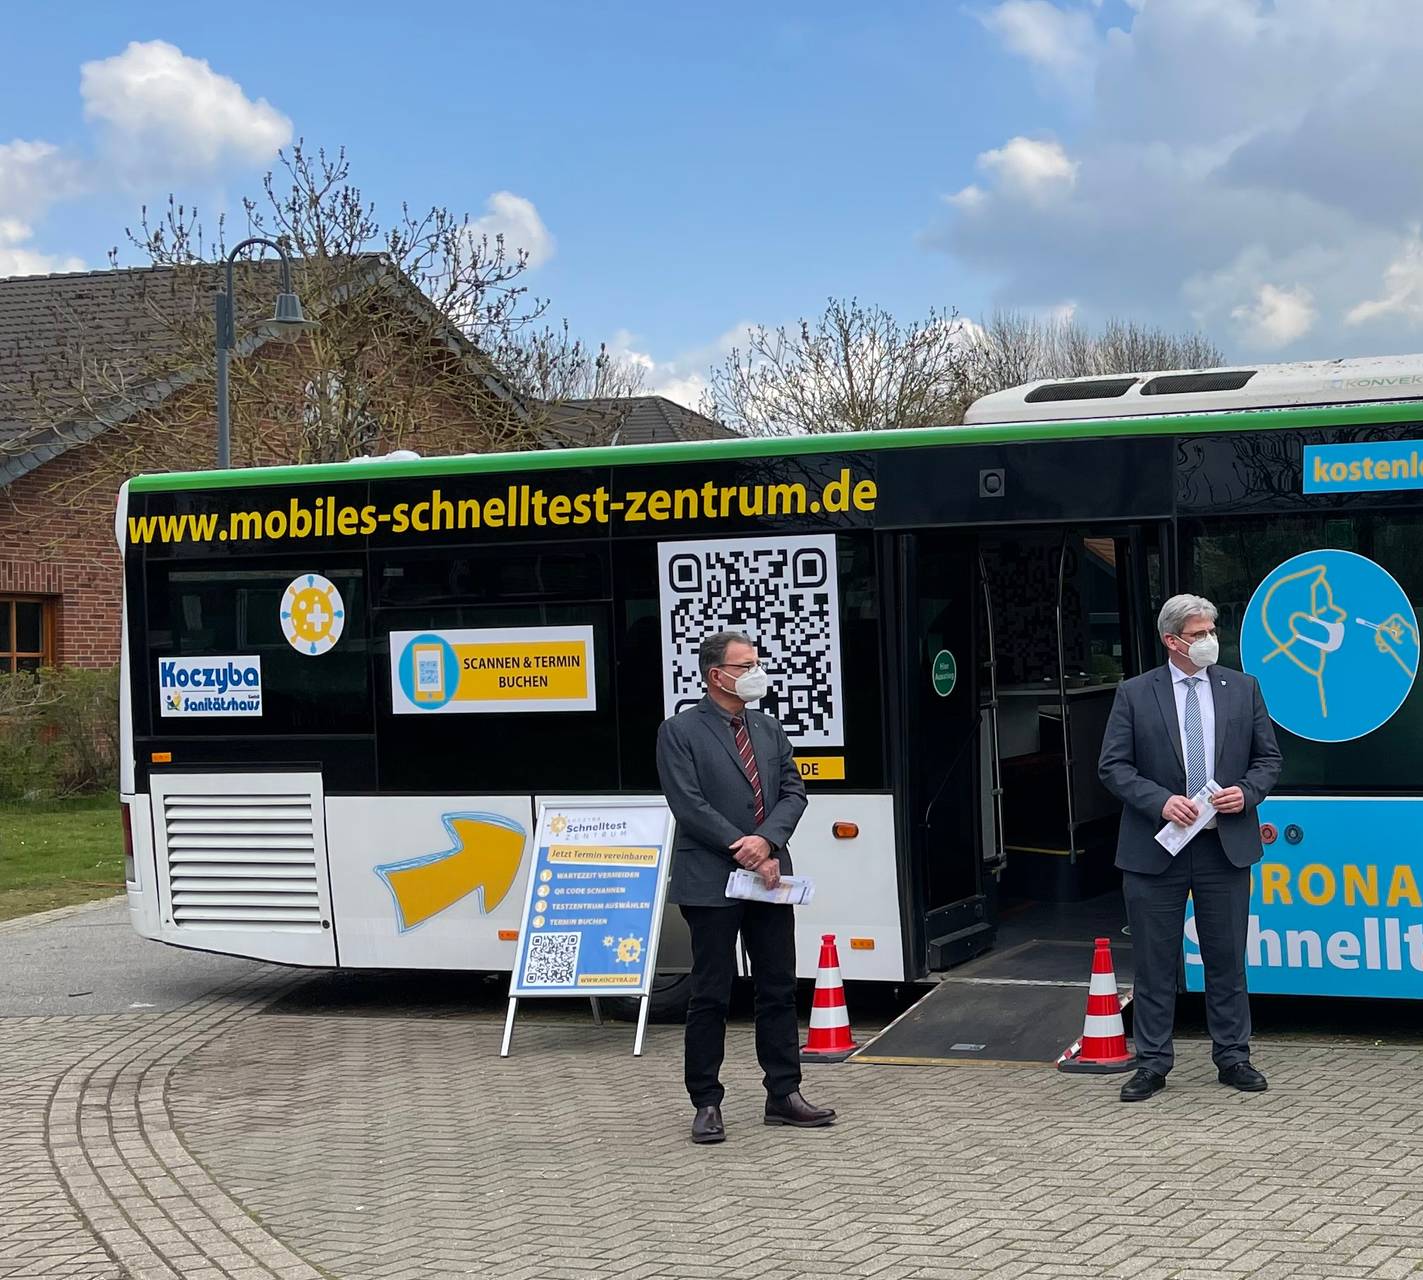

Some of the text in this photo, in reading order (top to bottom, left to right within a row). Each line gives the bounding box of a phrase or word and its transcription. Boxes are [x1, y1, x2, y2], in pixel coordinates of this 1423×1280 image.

[128, 468, 877, 544] www.mobiles-schnelltest-zentrum.de
[463, 655, 580, 669] SCANNEN & TERMIN
[161, 662, 259, 694] Koczyba
[498, 676, 548, 688] BUCHEN
[184, 697, 260, 712] Sanitätshaus
[566, 821, 627, 833] Schnelltest
[551, 849, 654, 860] Jetzt Termin vereinbaren
[1250, 862, 1423, 908] RONA
